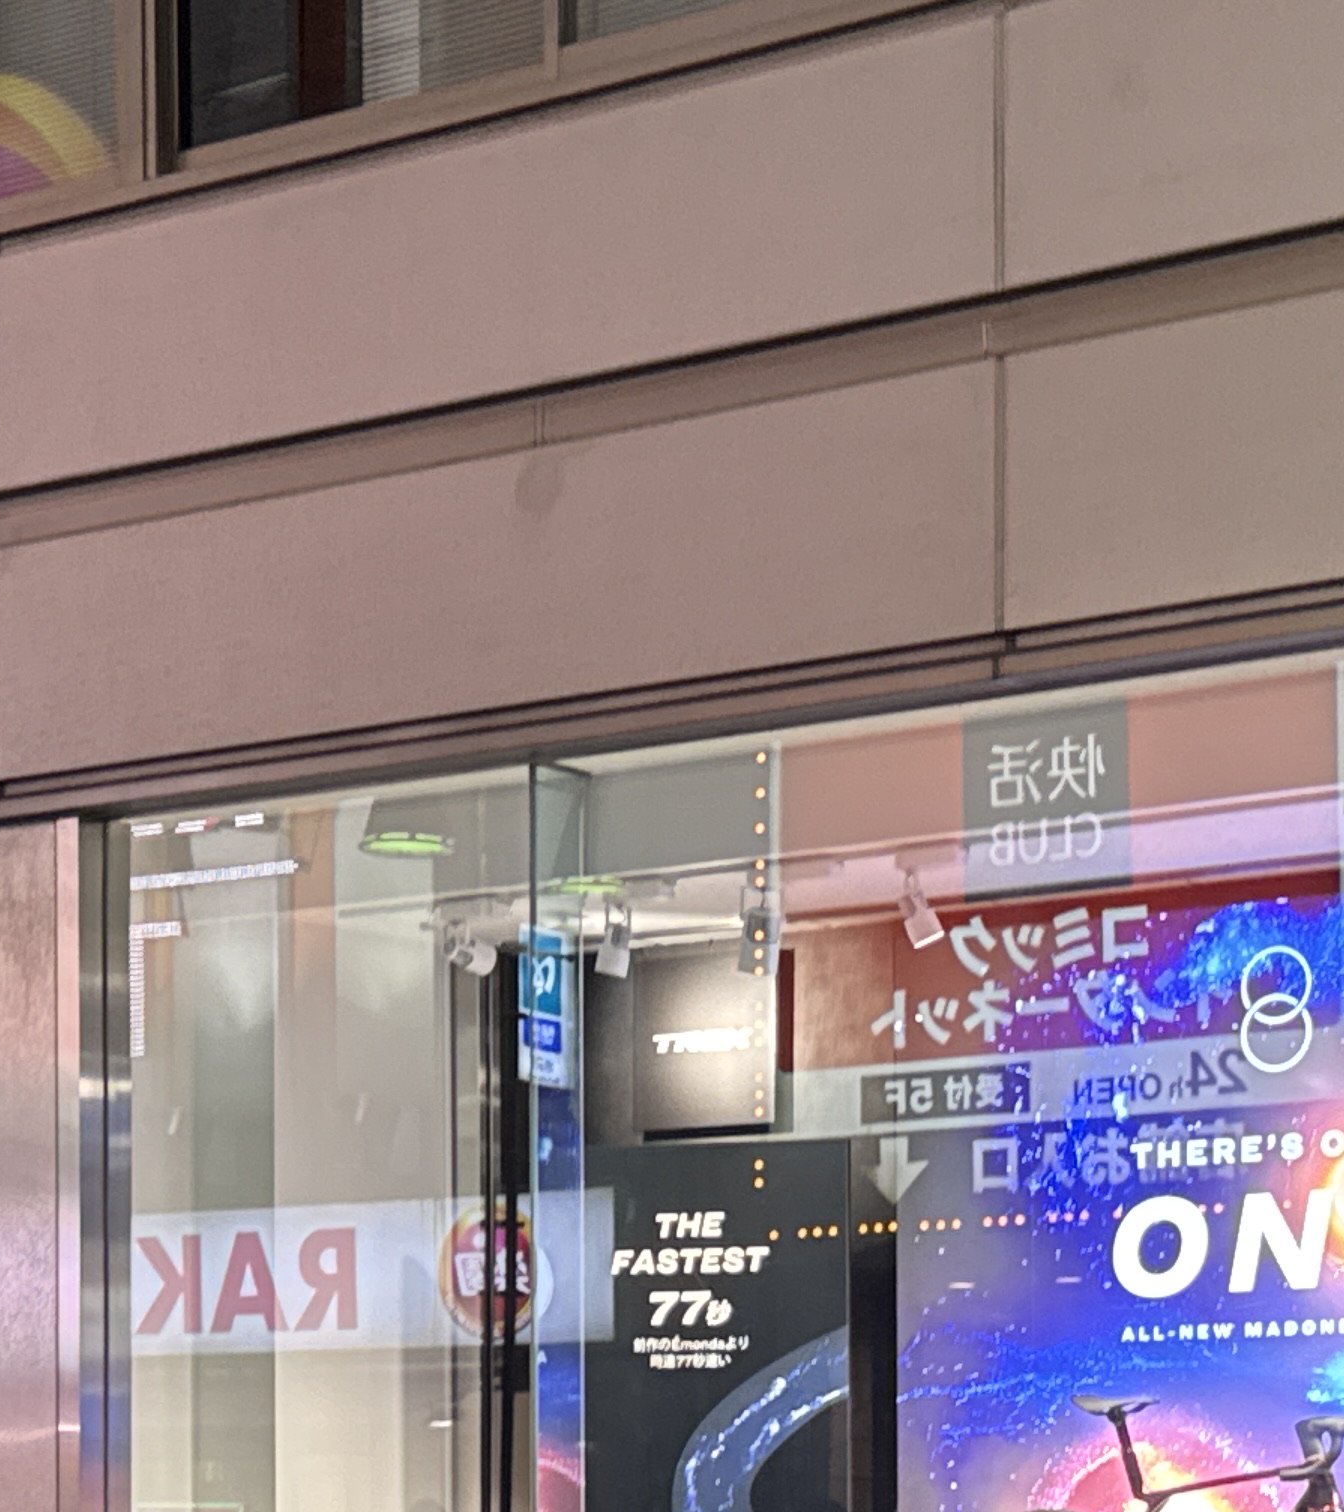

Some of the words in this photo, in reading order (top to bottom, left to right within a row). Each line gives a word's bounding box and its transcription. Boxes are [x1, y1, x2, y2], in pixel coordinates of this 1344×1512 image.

[1129, 1131, 1305, 1170] THERE'S
[655, 1211, 726, 1239] THE
[611, 1246, 771, 1275] FASTEST
[1120, 1322, 1235, 1343] ALL-NEW
